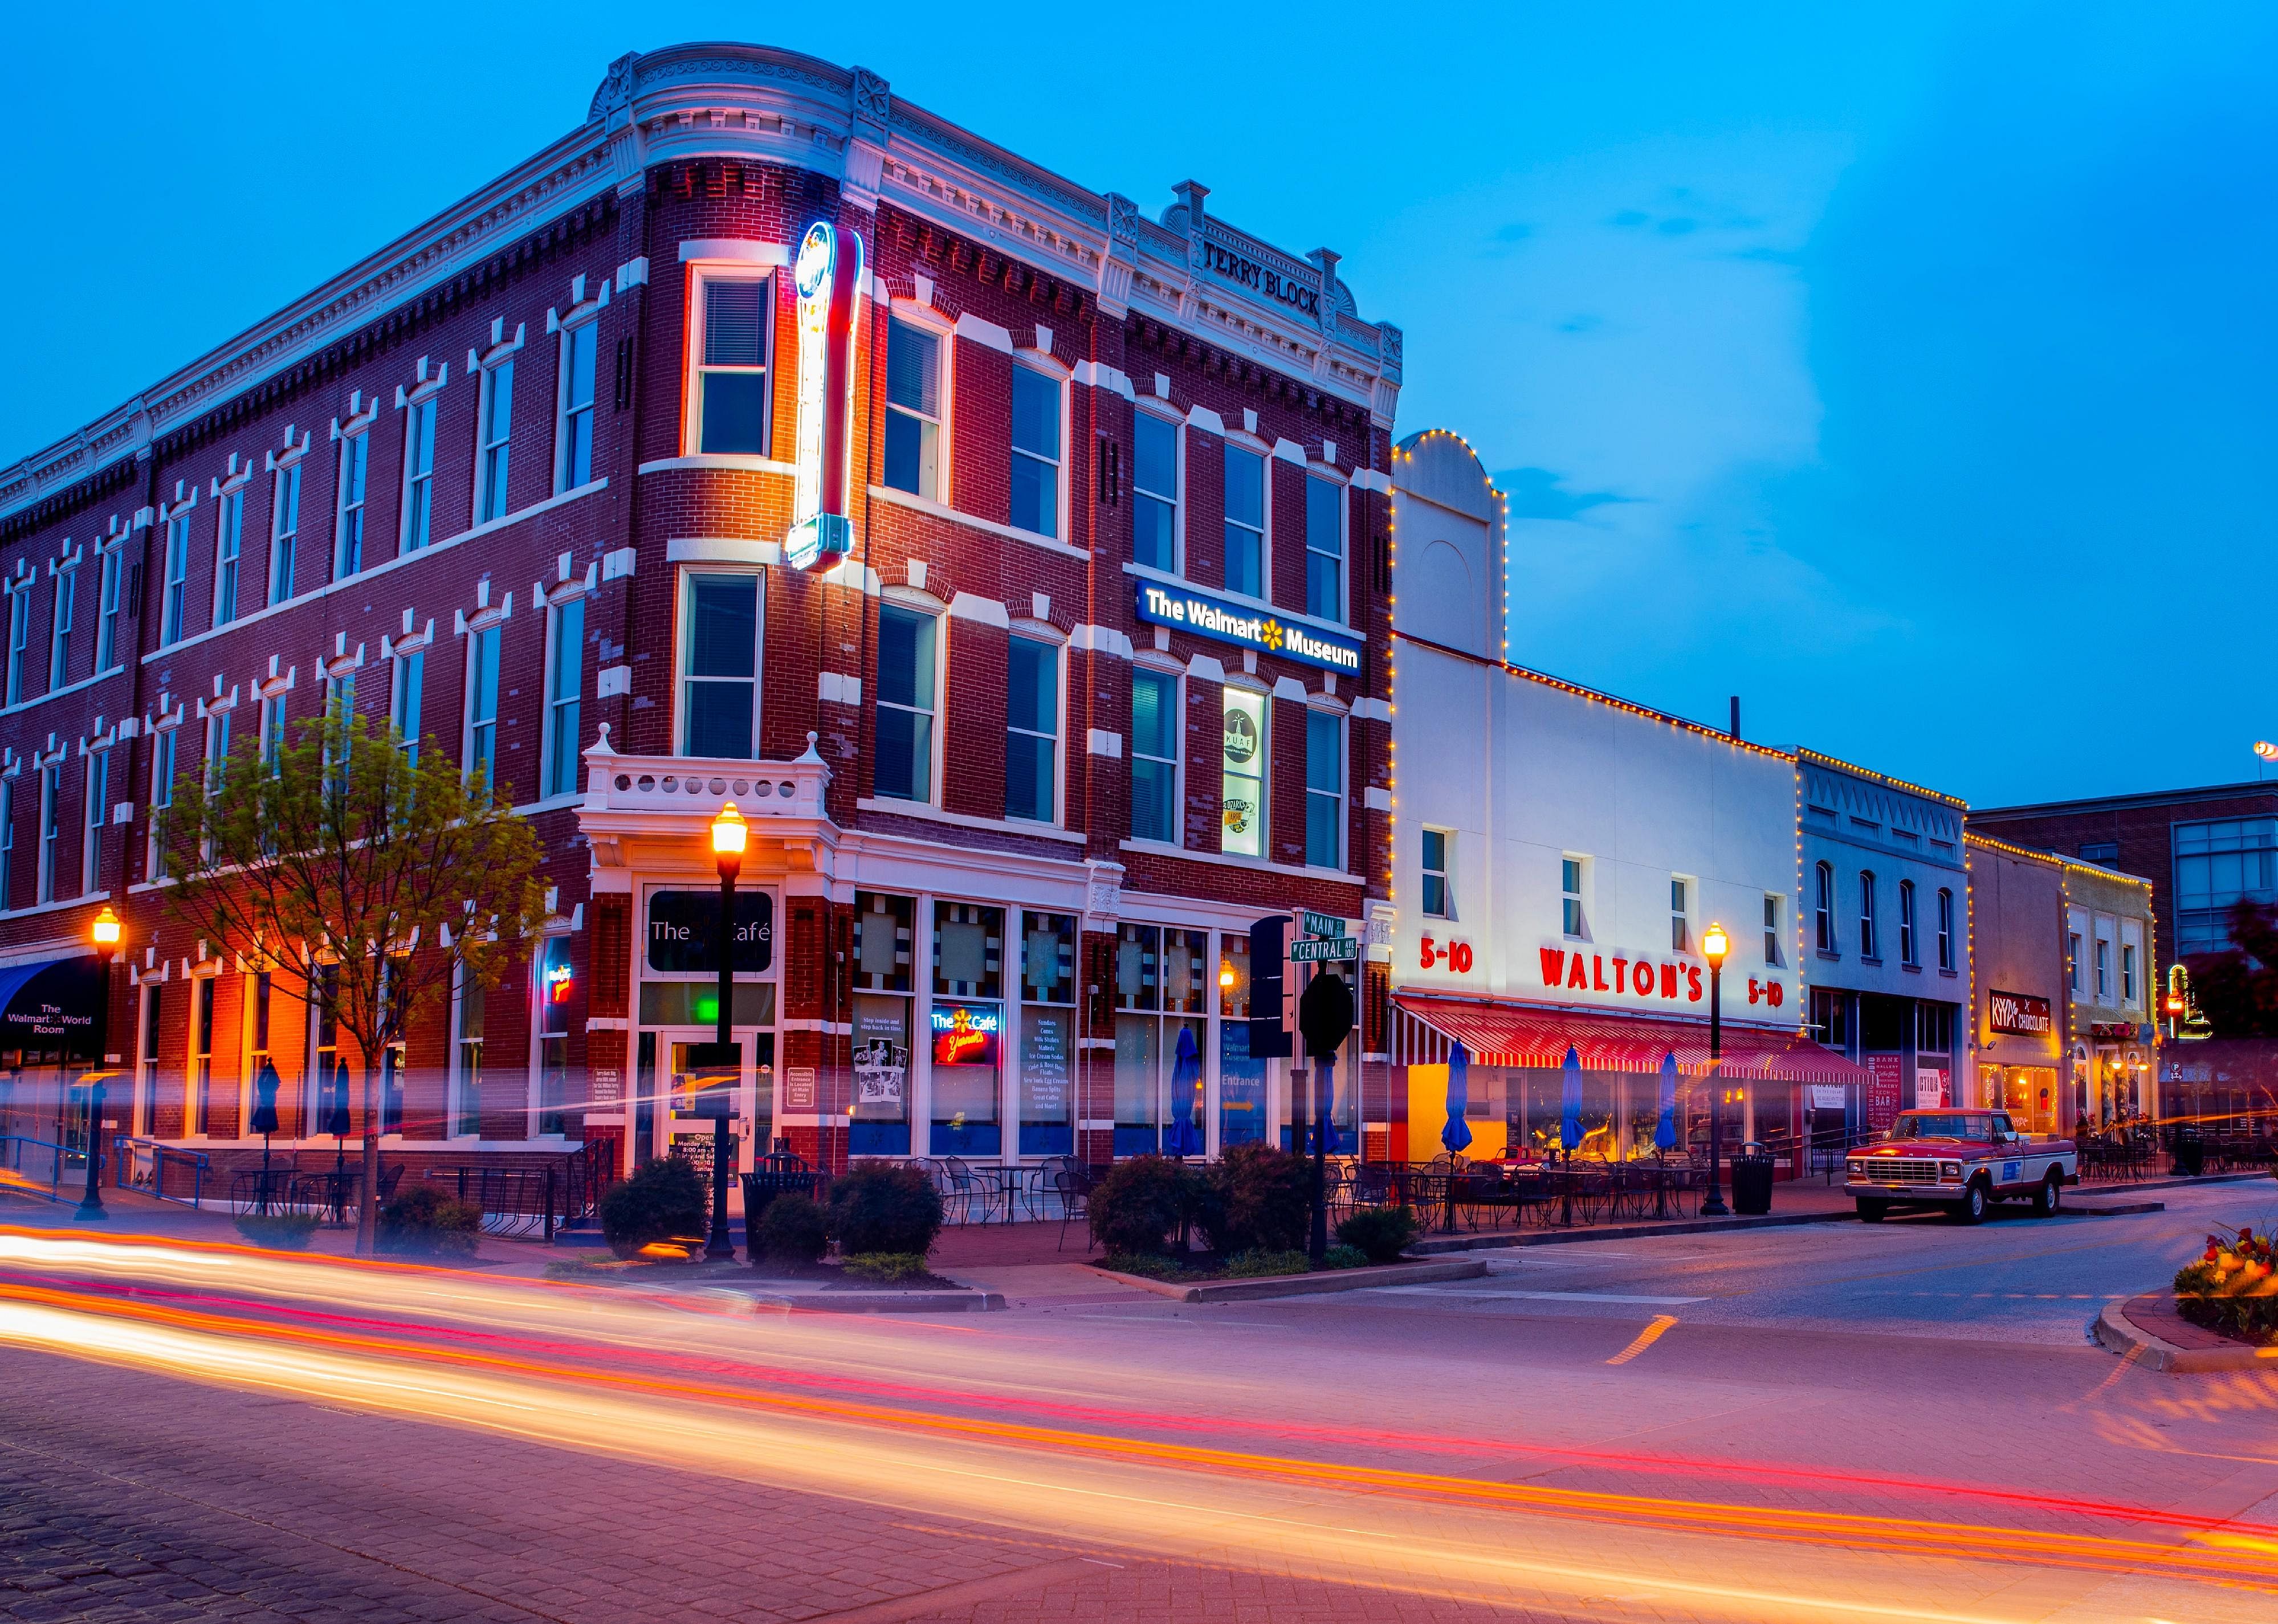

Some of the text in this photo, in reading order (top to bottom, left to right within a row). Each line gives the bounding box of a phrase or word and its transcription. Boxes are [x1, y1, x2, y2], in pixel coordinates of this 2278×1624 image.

[1204, 241, 1319, 315] TERRY BLOCK
[1146, 588, 1358, 668] The Walmart Museum
[1226, 735, 1250, 747] KUAF
[1227, 800, 1245, 809] OZARKS
[651, 921, 770, 941] The afé
[1306, 914, 1343, 936] N MAIN ST
[1335, 930, 1343, 939] 100
[1293, 940, 1355, 960] W CENTRAL AVE
[1345, 949, 1354, 958] 100
[1420, 937, 1473, 973] 5-10
[1540, 948, 1702, 1002] WALTON'S
[1749, 978, 1783, 1007] 5-10
[41, 1004, 61, 1013] The
[7, 1014, 92, 1025] Walmart World
[931, 1013, 997, 1031] The Café
[2018, 1013, 2049, 1032] CHOCOLATE
[33, 1025, 64, 1034] Room
[1221, 1074, 1260, 1086] Entrance
[1876, 1096, 1890, 1106] BAR
[695, 1133, 714, 1142] Open
